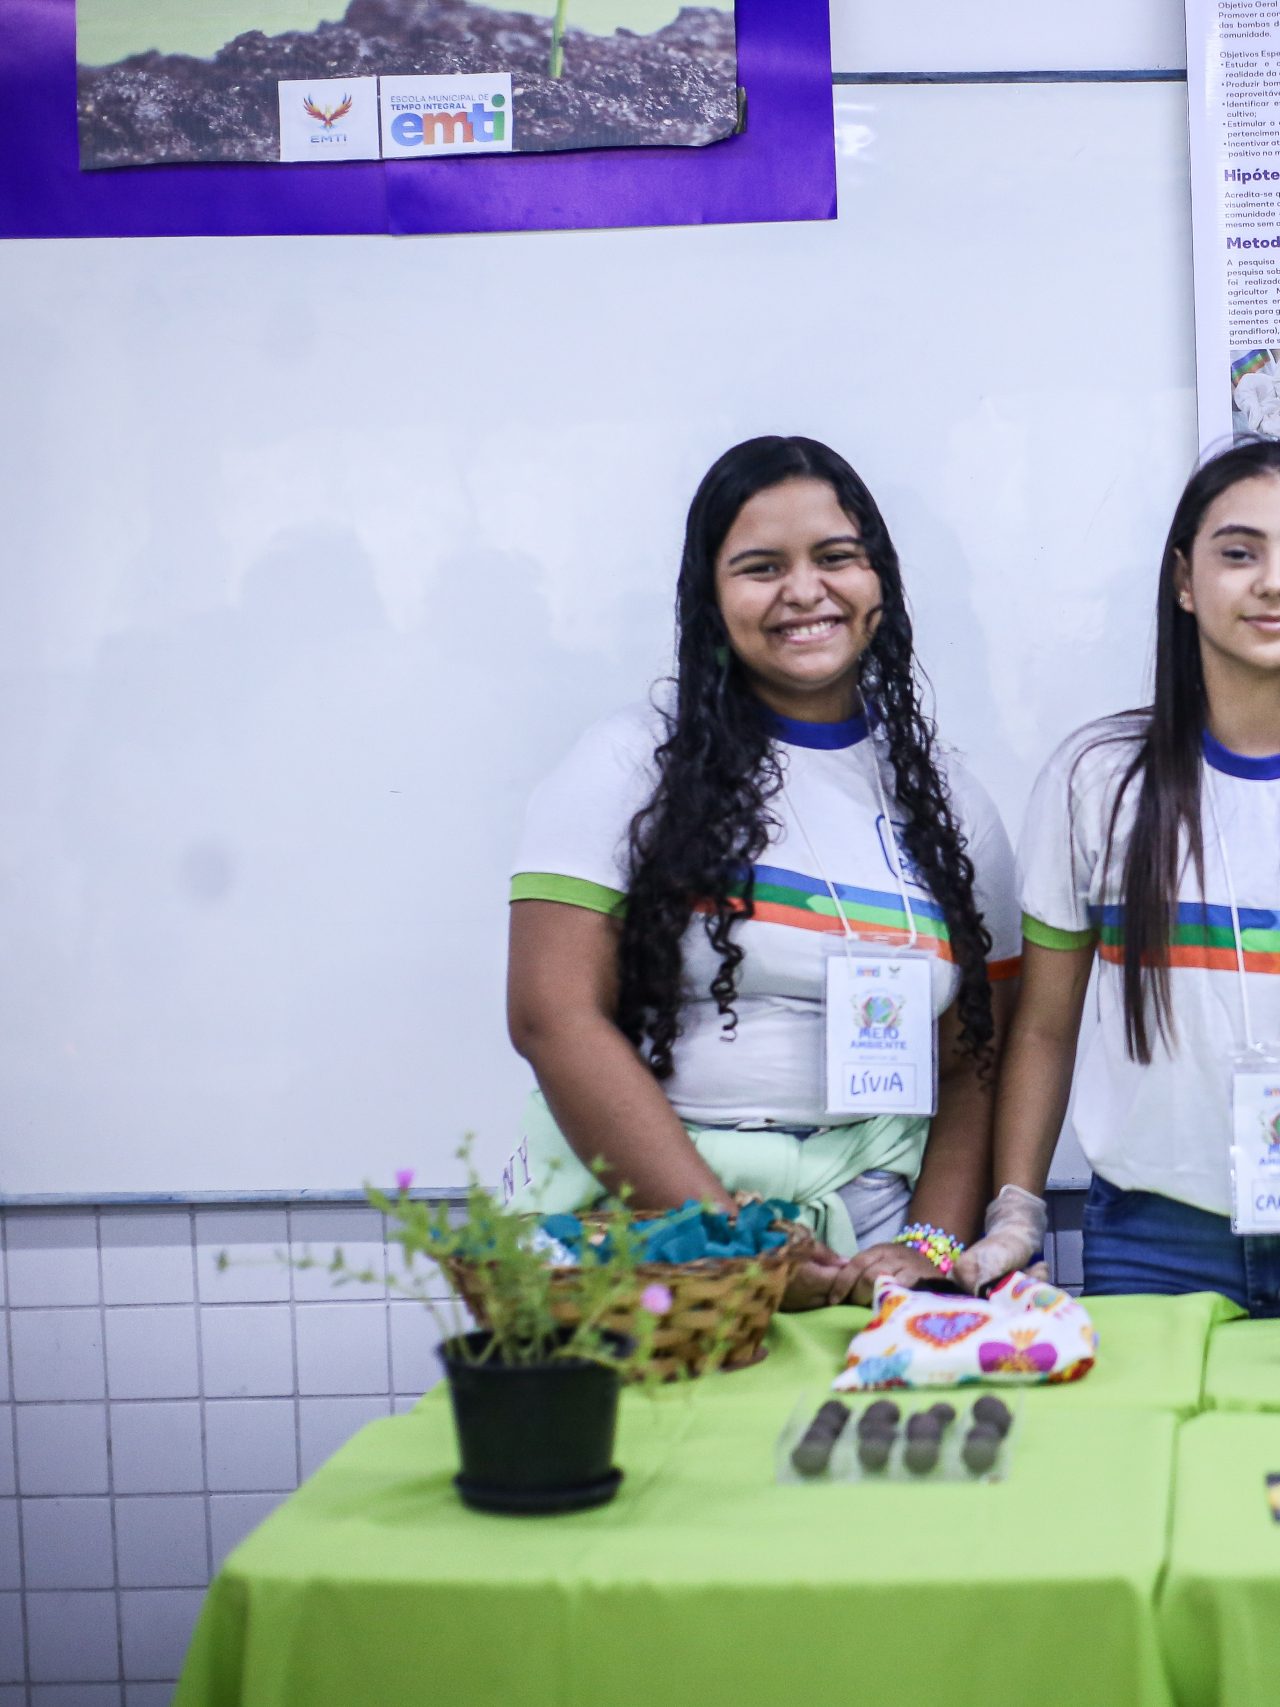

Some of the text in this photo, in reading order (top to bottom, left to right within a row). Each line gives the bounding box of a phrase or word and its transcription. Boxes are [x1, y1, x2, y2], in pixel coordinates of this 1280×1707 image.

[391, 94, 505, 146] emti
[311, 134, 347, 143] EMTI
[859, 1028, 899, 1040] MEIO
[851, 1071, 903, 1095] LÍVIA
